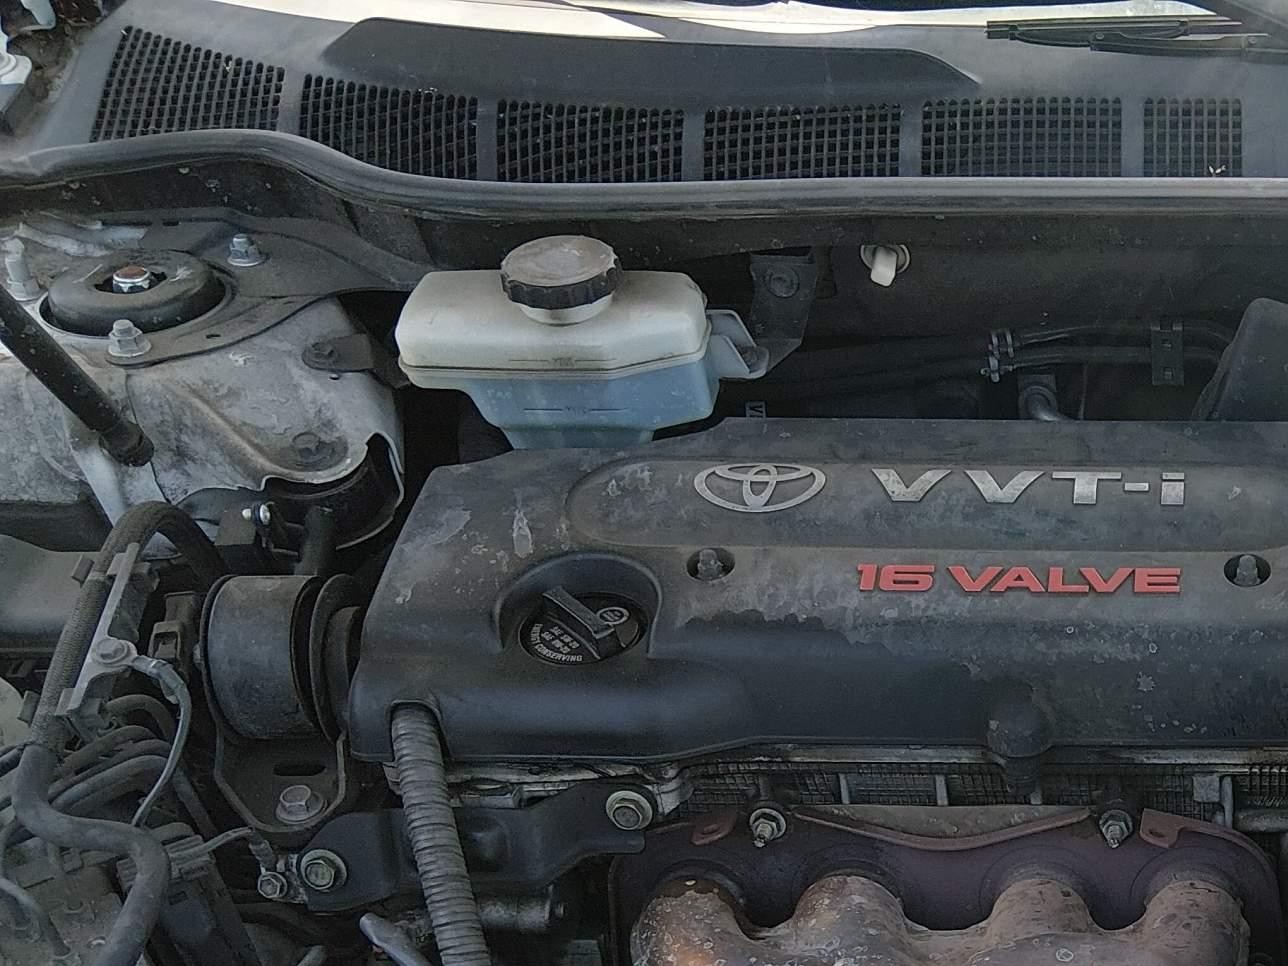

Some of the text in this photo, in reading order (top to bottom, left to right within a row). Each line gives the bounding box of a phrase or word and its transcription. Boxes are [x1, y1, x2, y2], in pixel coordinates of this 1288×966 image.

[871, 467, 1186, 506] VVT-i
[857, 563, 1182, 593] 16 VALVE
[534, 643, 583, 662] CONSERVING
